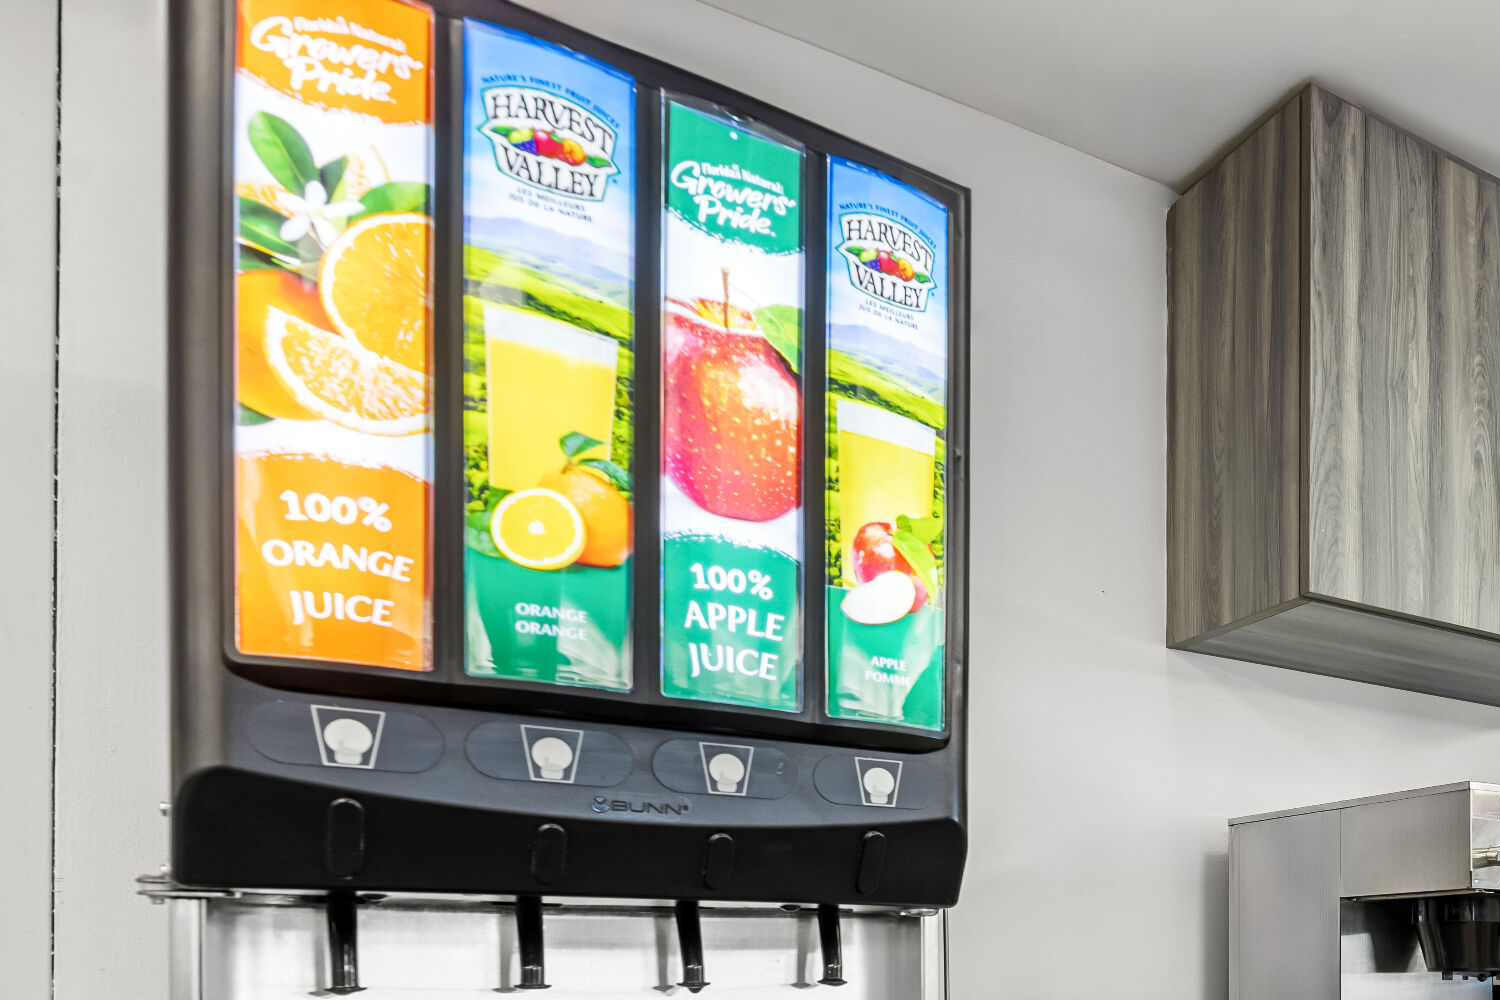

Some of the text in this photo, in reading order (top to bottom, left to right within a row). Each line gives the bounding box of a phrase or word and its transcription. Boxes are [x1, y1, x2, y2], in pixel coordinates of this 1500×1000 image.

[490, 93, 615, 155] HARVEST
[500, 143, 600, 197] VALLEY
[847, 219, 932, 271] HARVEST
[853, 261, 924, 309] VALLEY
[279, 489, 393, 532] 100%
[261, 538, 415, 583] ORANGE
[690, 562, 774, 600] 100%
[289, 590, 395, 627] JUICE
[514, 602, 588, 624] ORANGE
[684, 600, 785, 642] APPLE
[514, 620, 588, 641] ORANGE
[688, 642, 779, 681] JUICE
[864, 670, 913, 689] POMME
[871, 655, 907, 672] APPLE
[611, 800, 682, 816] BUNN
